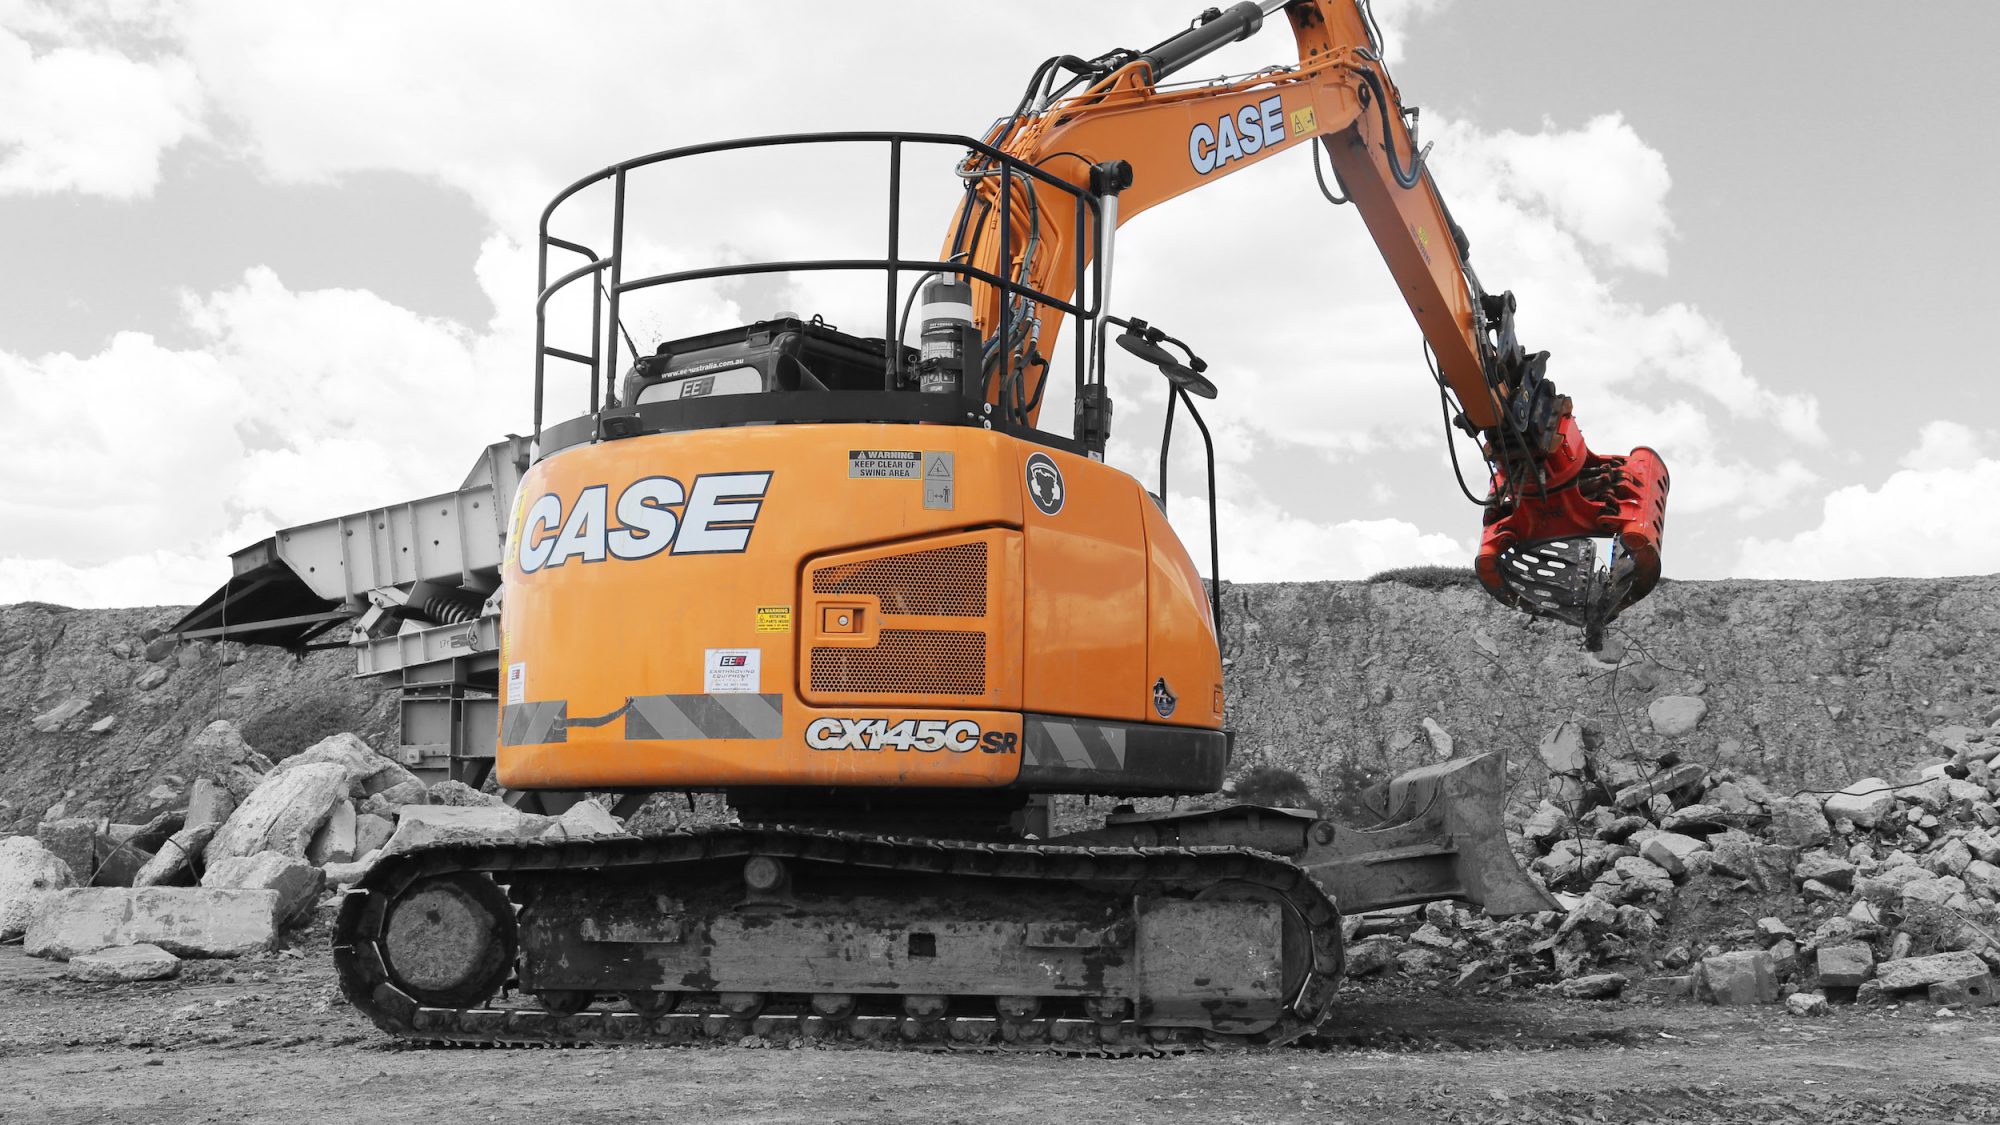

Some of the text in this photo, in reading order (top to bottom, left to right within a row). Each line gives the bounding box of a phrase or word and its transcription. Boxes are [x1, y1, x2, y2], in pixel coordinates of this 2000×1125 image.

[1189, 94, 1286, 175] CASE
[854, 460, 916, 469] KEEP CLEAR OF
[868, 451, 914, 459] WARNING
[860, 469, 910, 477] SWING AREA
[519, 470, 774, 574] CASE
[804, 717, 1018, 754] CX145C SR
